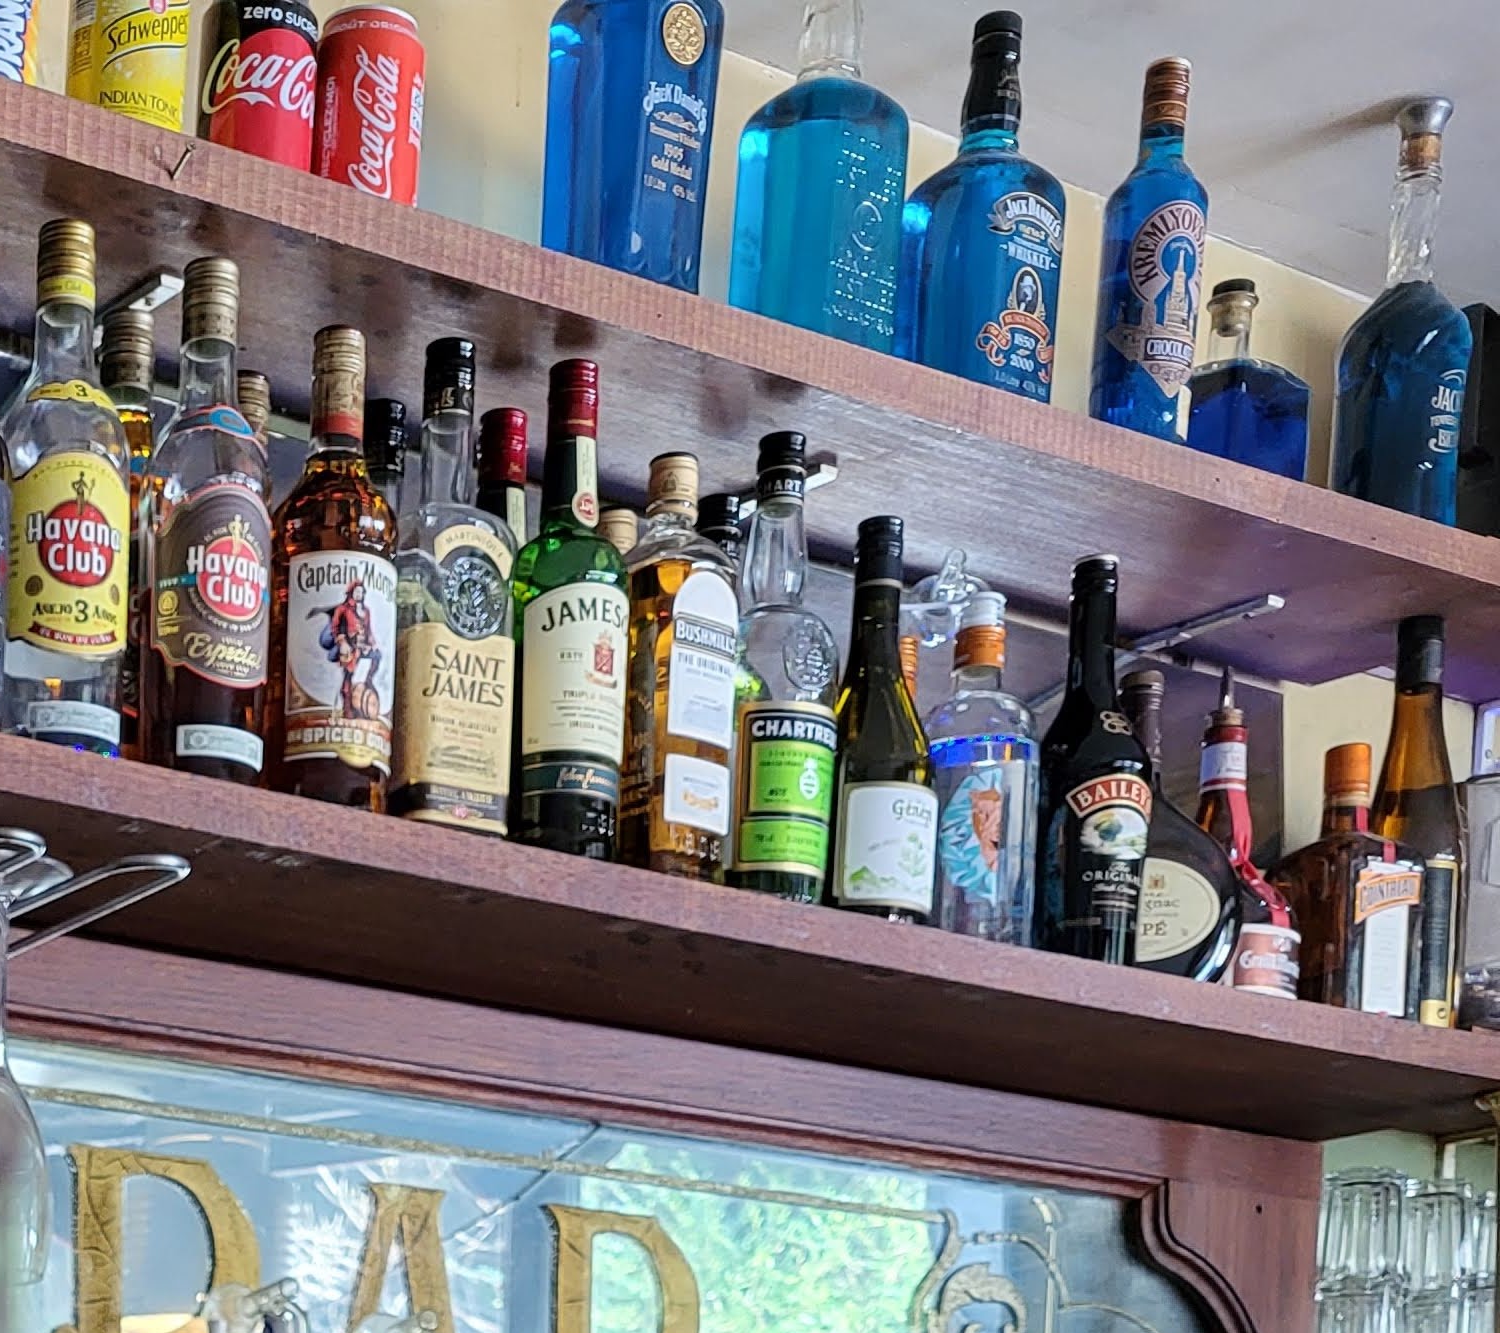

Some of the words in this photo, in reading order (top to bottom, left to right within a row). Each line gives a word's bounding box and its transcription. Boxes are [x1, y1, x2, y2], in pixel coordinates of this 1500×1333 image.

[243, 5, 283, 21] zero
[106, 14, 189, 55] Schweppe
[346, 44, 401, 200] Coca-Cola
[1132, 205, 1206, 289] KREMLYOVS
[75, 384, 89, 398] 3
[1431, 385, 1463, 413] JAC
[27, 511, 121, 553] Havana
[47, 542, 107, 578] Club
[186, 544, 268, 588] Havana
[297, 558, 359, 594] Captain
[206, 574, 257, 609] Club
[73, 599, 90, 623] 3
[431, 642, 506, 683] SAINT
[422, 671, 505, 709] JAMES
[1075, 780, 1150, 809] BAILEY
[1081, 869, 1142, 888] ORIGINA
